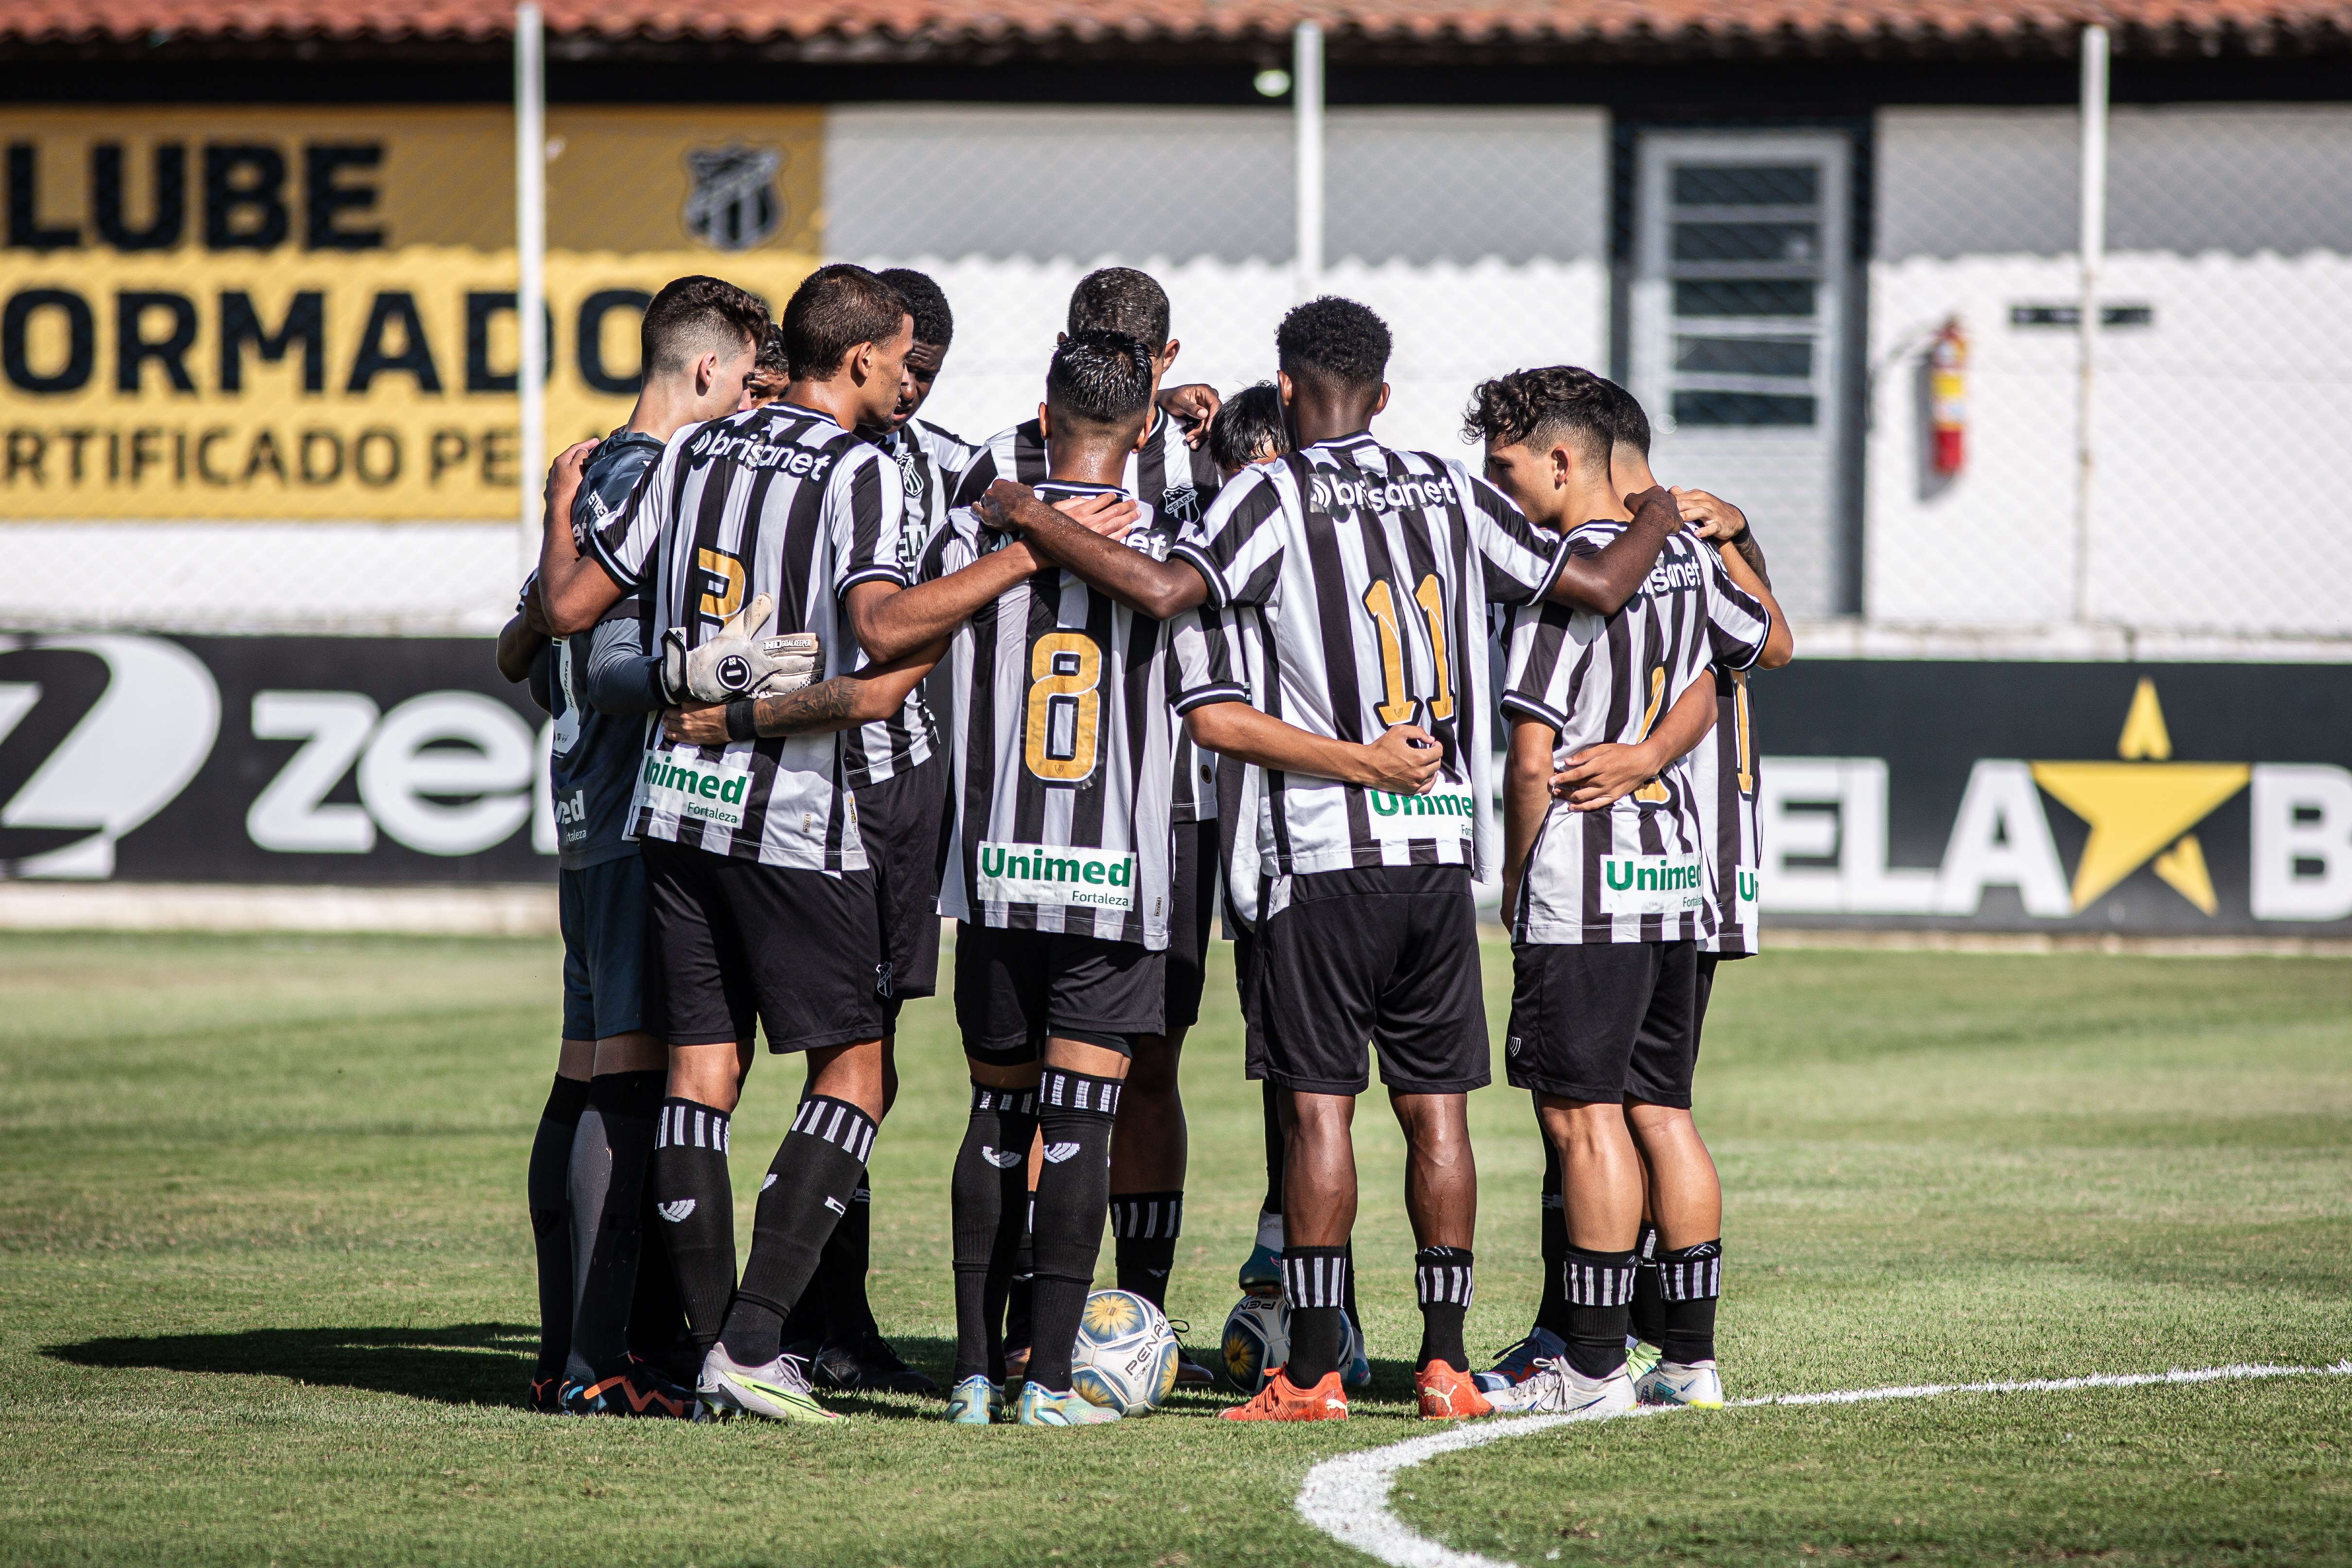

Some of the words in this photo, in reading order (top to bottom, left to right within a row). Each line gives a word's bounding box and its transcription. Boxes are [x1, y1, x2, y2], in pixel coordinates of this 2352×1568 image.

[5, 142, 384, 250] LUBE
[1, 288, 649, 396] ORMADO
[431, 427, 521, 488] PE
[706, 429, 831, 481] brisanet
[1330, 471, 1457, 508] brisanet
[781, 639, 811, 647] GOALKEEPER
[1365, 573, 1456, 726] 11
[1024, 632, 1102, 782] 8
[246, 690, 558, 856] ze
[687, 802, 738, 824] Fortaleza
[1370, 791, 1473, 819] Unime
[981, 847, 1133, 888] Unimed
[1072, 890, 1129, 907] Fortaleza
[1124, 1310, 1165, 1376] PENALT
